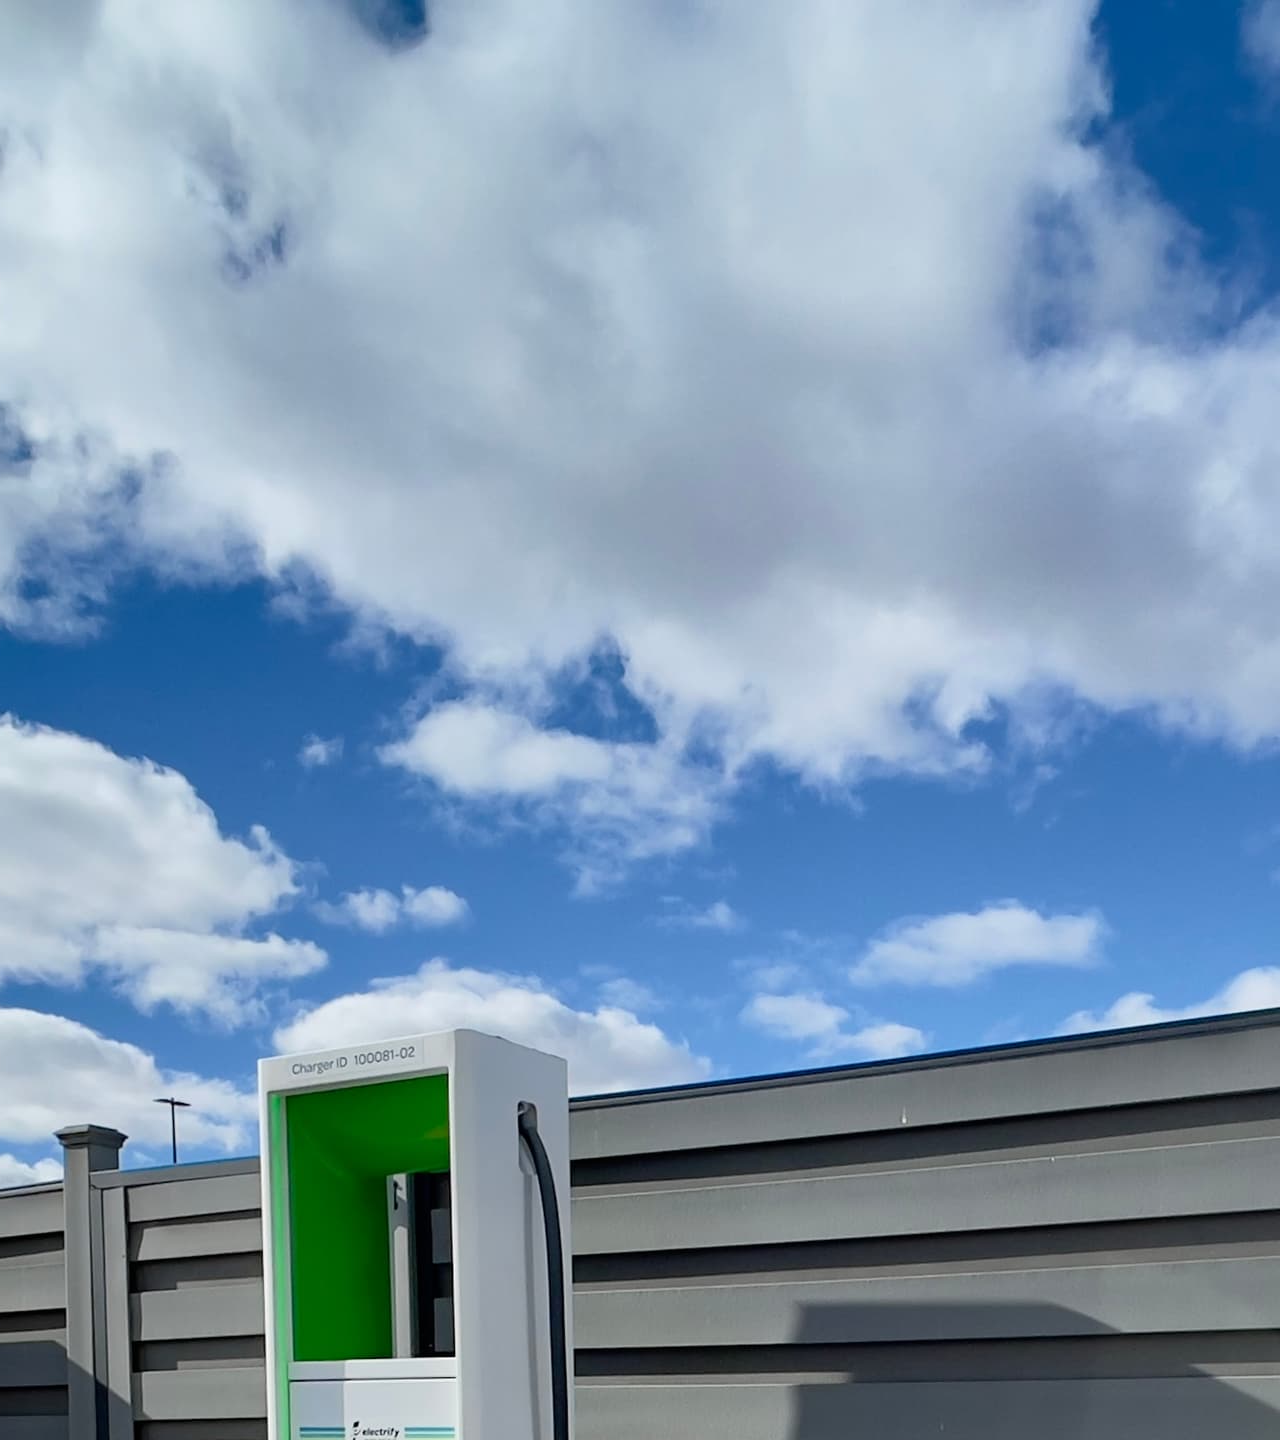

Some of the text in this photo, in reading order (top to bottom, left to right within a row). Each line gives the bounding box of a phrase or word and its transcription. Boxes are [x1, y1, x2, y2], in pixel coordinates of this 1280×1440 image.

[292, 1046, 415, 1075] Charger ID 100081-02
[362, 1427, 400, 1438] electrify
